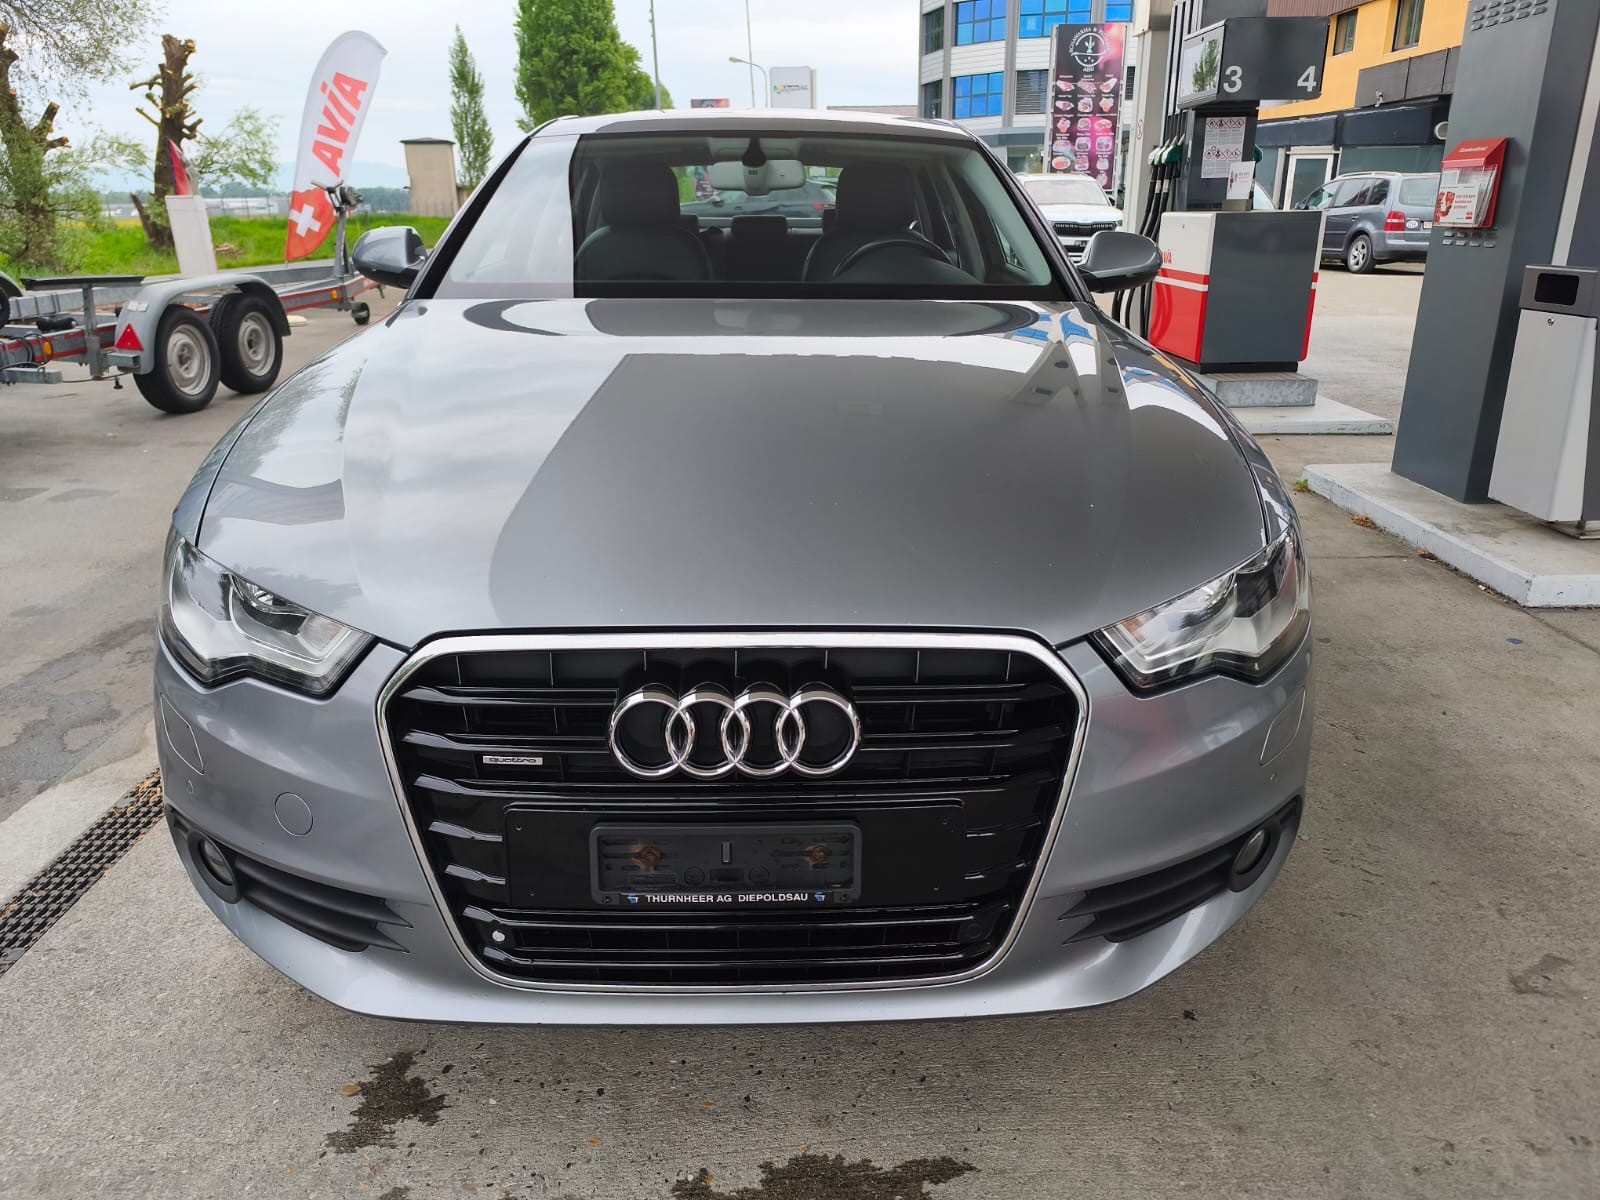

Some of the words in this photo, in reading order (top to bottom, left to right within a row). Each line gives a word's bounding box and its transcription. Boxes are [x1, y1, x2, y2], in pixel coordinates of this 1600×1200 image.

[1223, 65, 1242, 93] 3
[1297, 65, 1317, 92] 4
[312, 72, 368, 177] AVIA
[646, 894, 713, 903] THURNHEER
[717, 894, 732, 902] AG
[738, 893, 808, 902] DIEPOLDSAU
